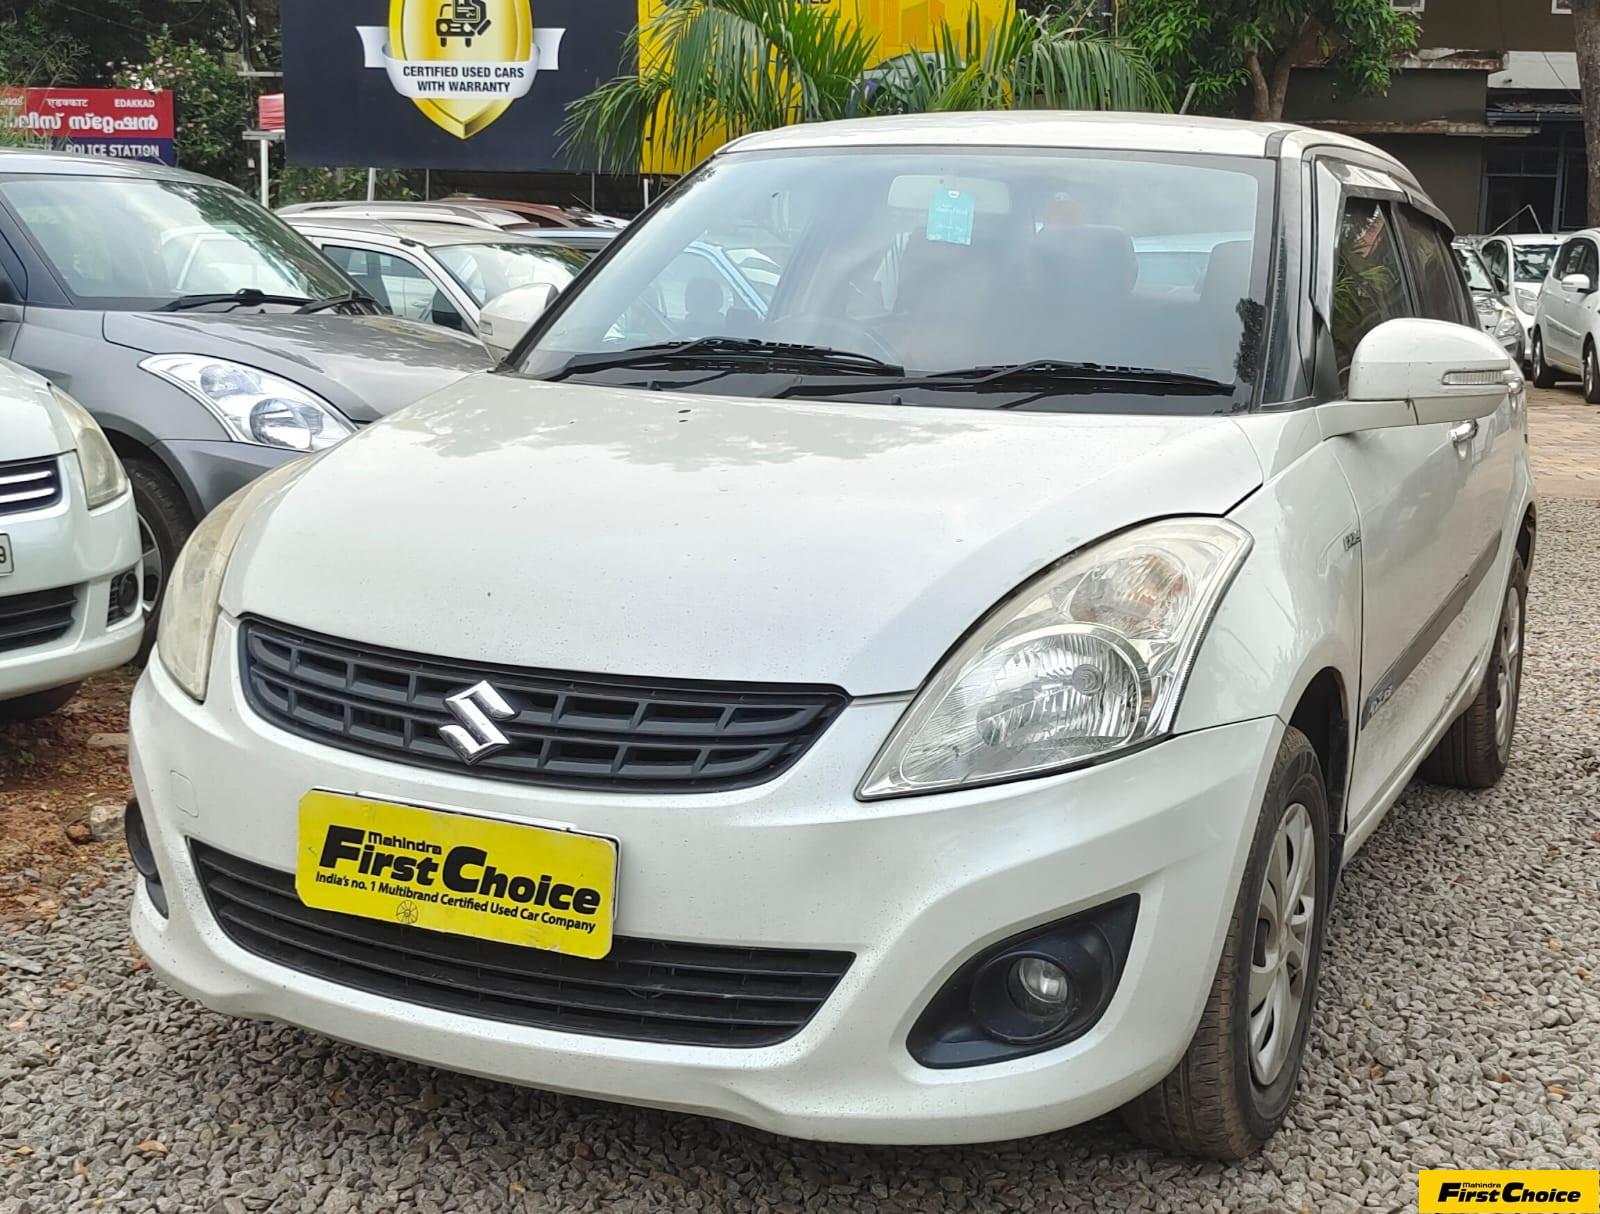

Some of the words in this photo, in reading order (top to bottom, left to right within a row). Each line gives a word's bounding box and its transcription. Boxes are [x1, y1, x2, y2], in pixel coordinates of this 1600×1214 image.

[403, 66, 458, 77] CERTIFIED
[462, 66, 491, 78] USED
[494, 67, 524, 78] CARS
[417, 81, 445, 92] WITH
[448, 81, 510, 92] WARRANTY
[114, 98, 155, 108] EDAKKAD
[66, 144, 107, 157] POLICE
[108, 144, 160, 157] STATION
[319, 825, 440, 886] First
[442, 846, 601, 915] Choice
[315, 872, 349, 887] India's
[351, 879, 368, 891] no.
[370, 880, 376, 892] 1
[378, 881, 439, 903] Multibrand
[440, 893, 488, 913] Certified
[490, 903, 518, 918] Used
[520, 907, 540, 922] Car
[541, 911, 596, 934] Company
